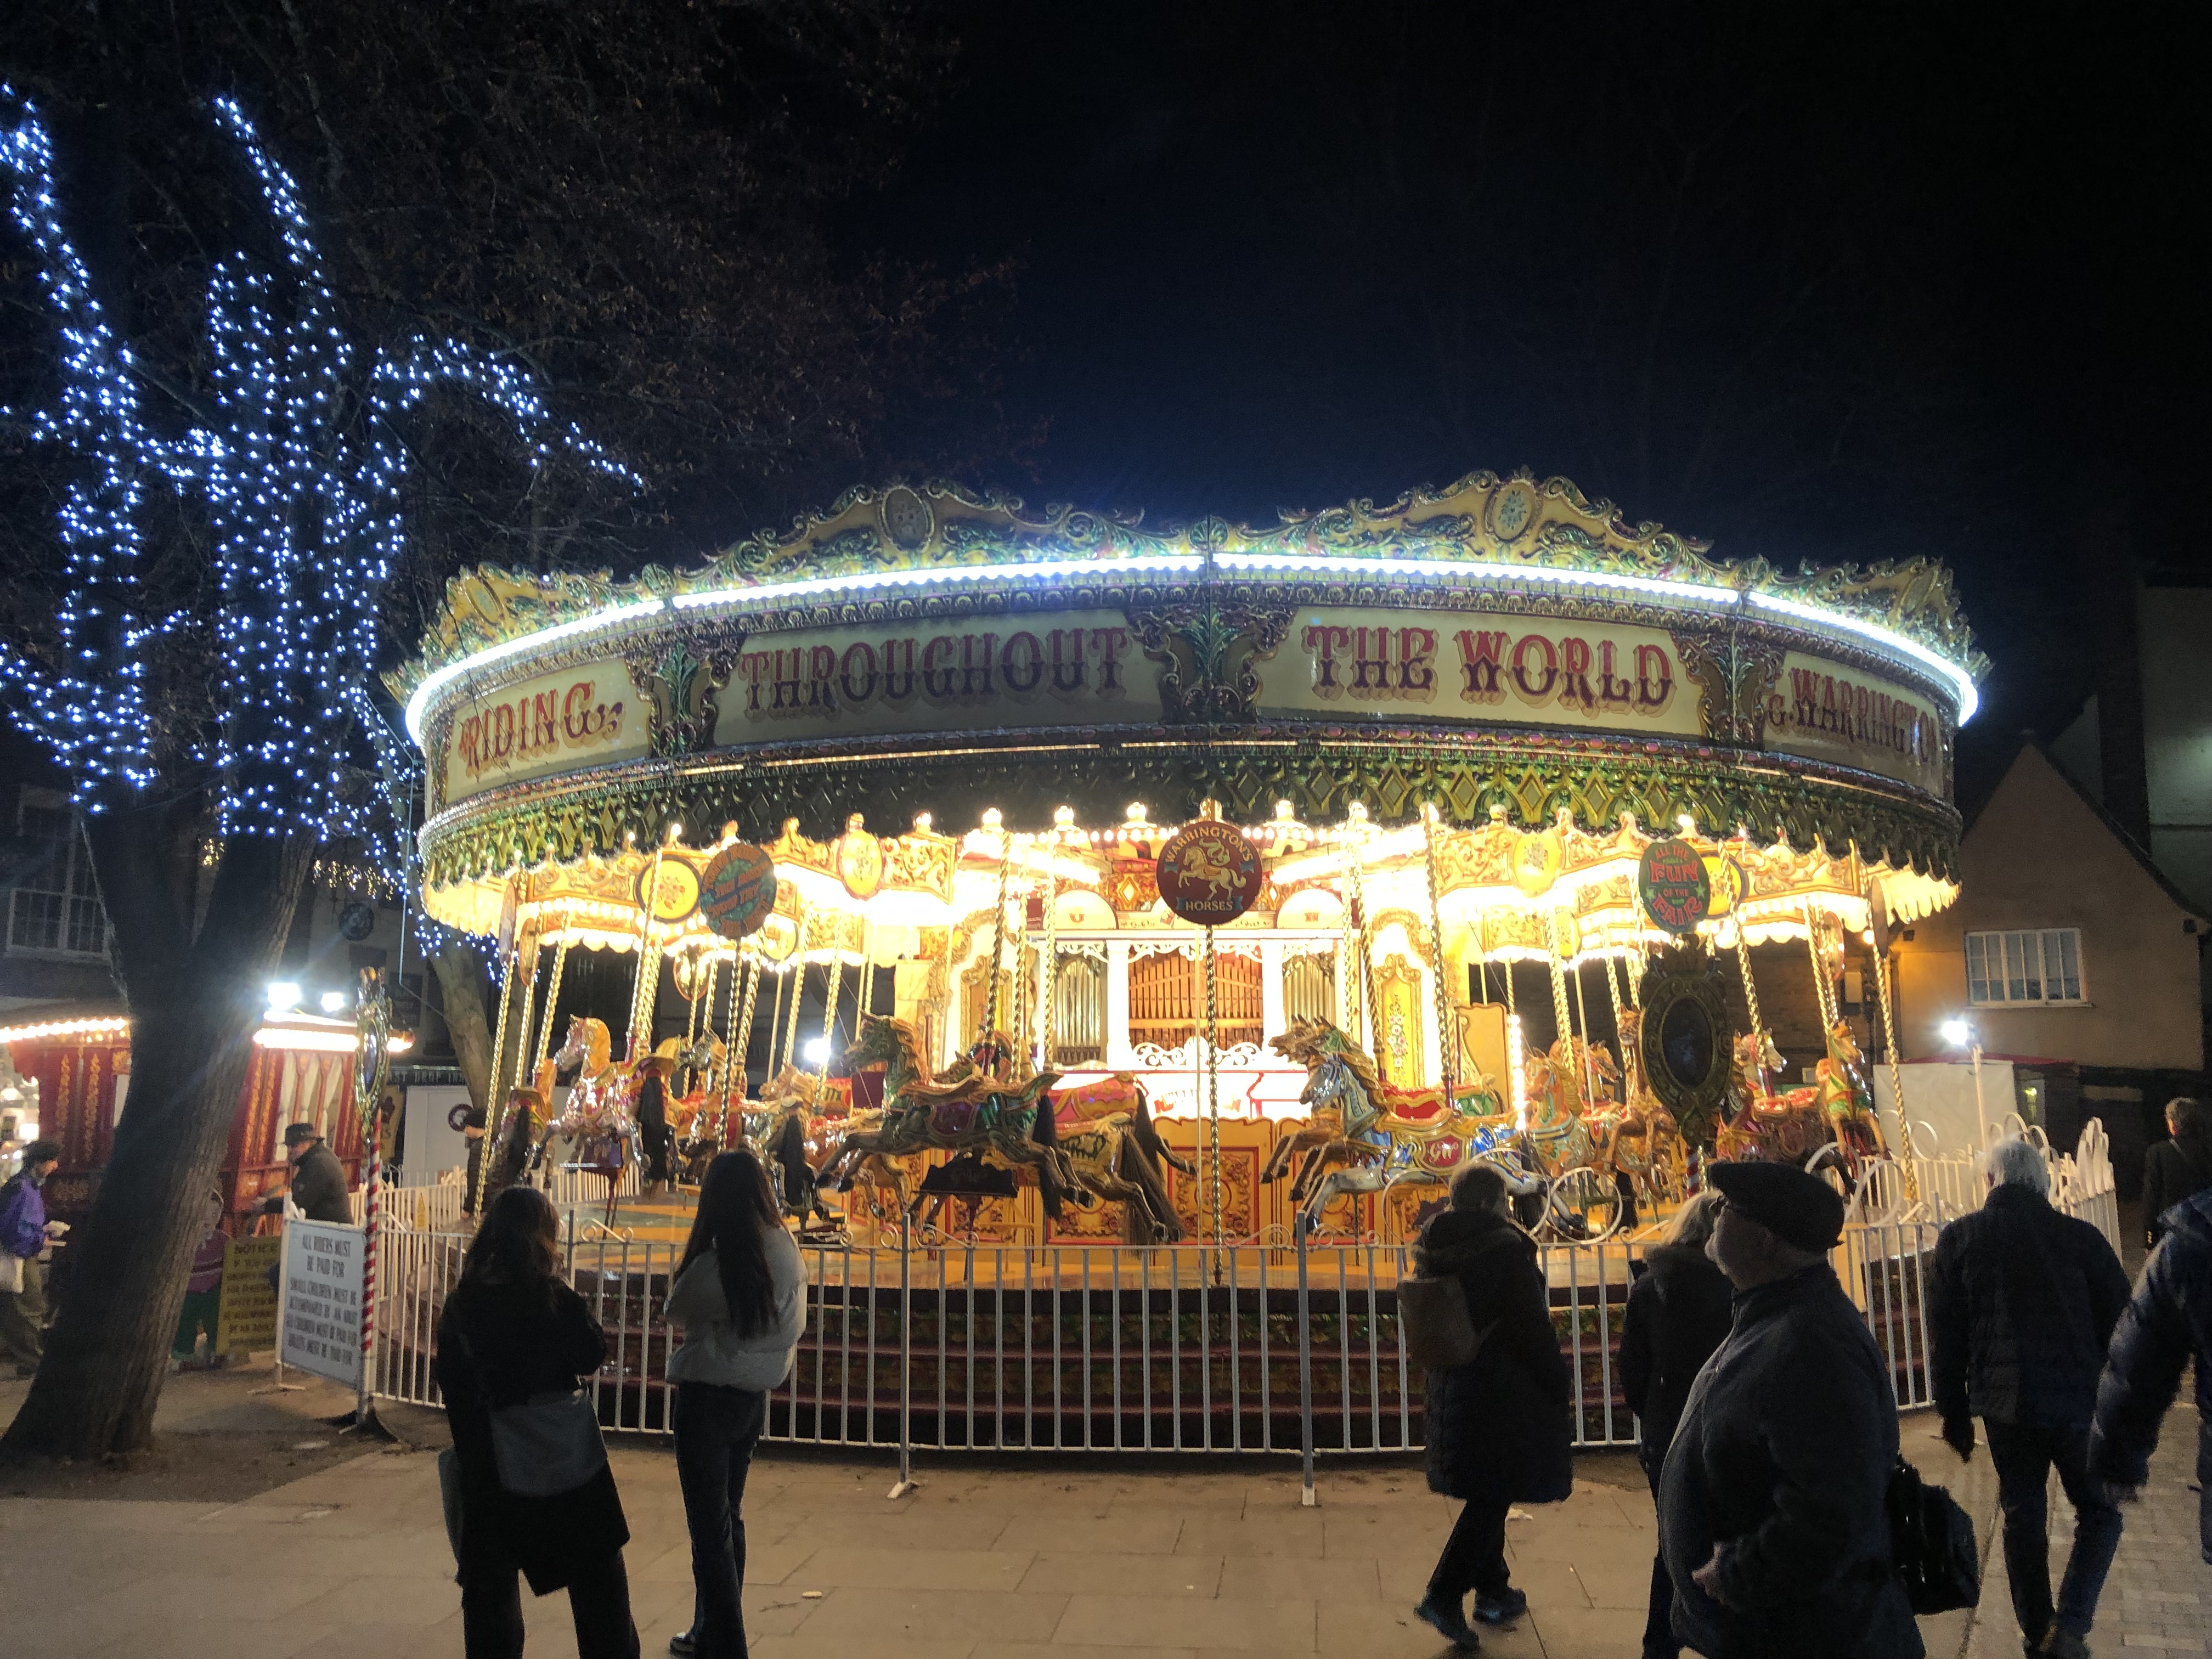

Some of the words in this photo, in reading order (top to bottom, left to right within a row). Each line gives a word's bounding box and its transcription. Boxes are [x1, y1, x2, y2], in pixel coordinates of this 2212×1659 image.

[742, 628, 1128, 712] THROUGHOUT
[1307, 625, 1437, 692] THE
[1458, 630, 1674, 711] WORLD
[1655, 846, 1671, 860] ALL
[1672, 844, 1689, 859] THE
[1650, 860, 1699, 883] FUN
[1663, 889, 1673, 898] OF
[1675, 888, 1689, 897] THE
[1185, 900, 1233, 911] HORSES
[1652, 893, 1703, 926] FAIR
[234, 1243, 278, 1255] NOTICE
[335, 1239, 351, 1257] MUST
[317, 1257, 331, 1276] PAID
[332, 1259, 345, 1278] FOR
